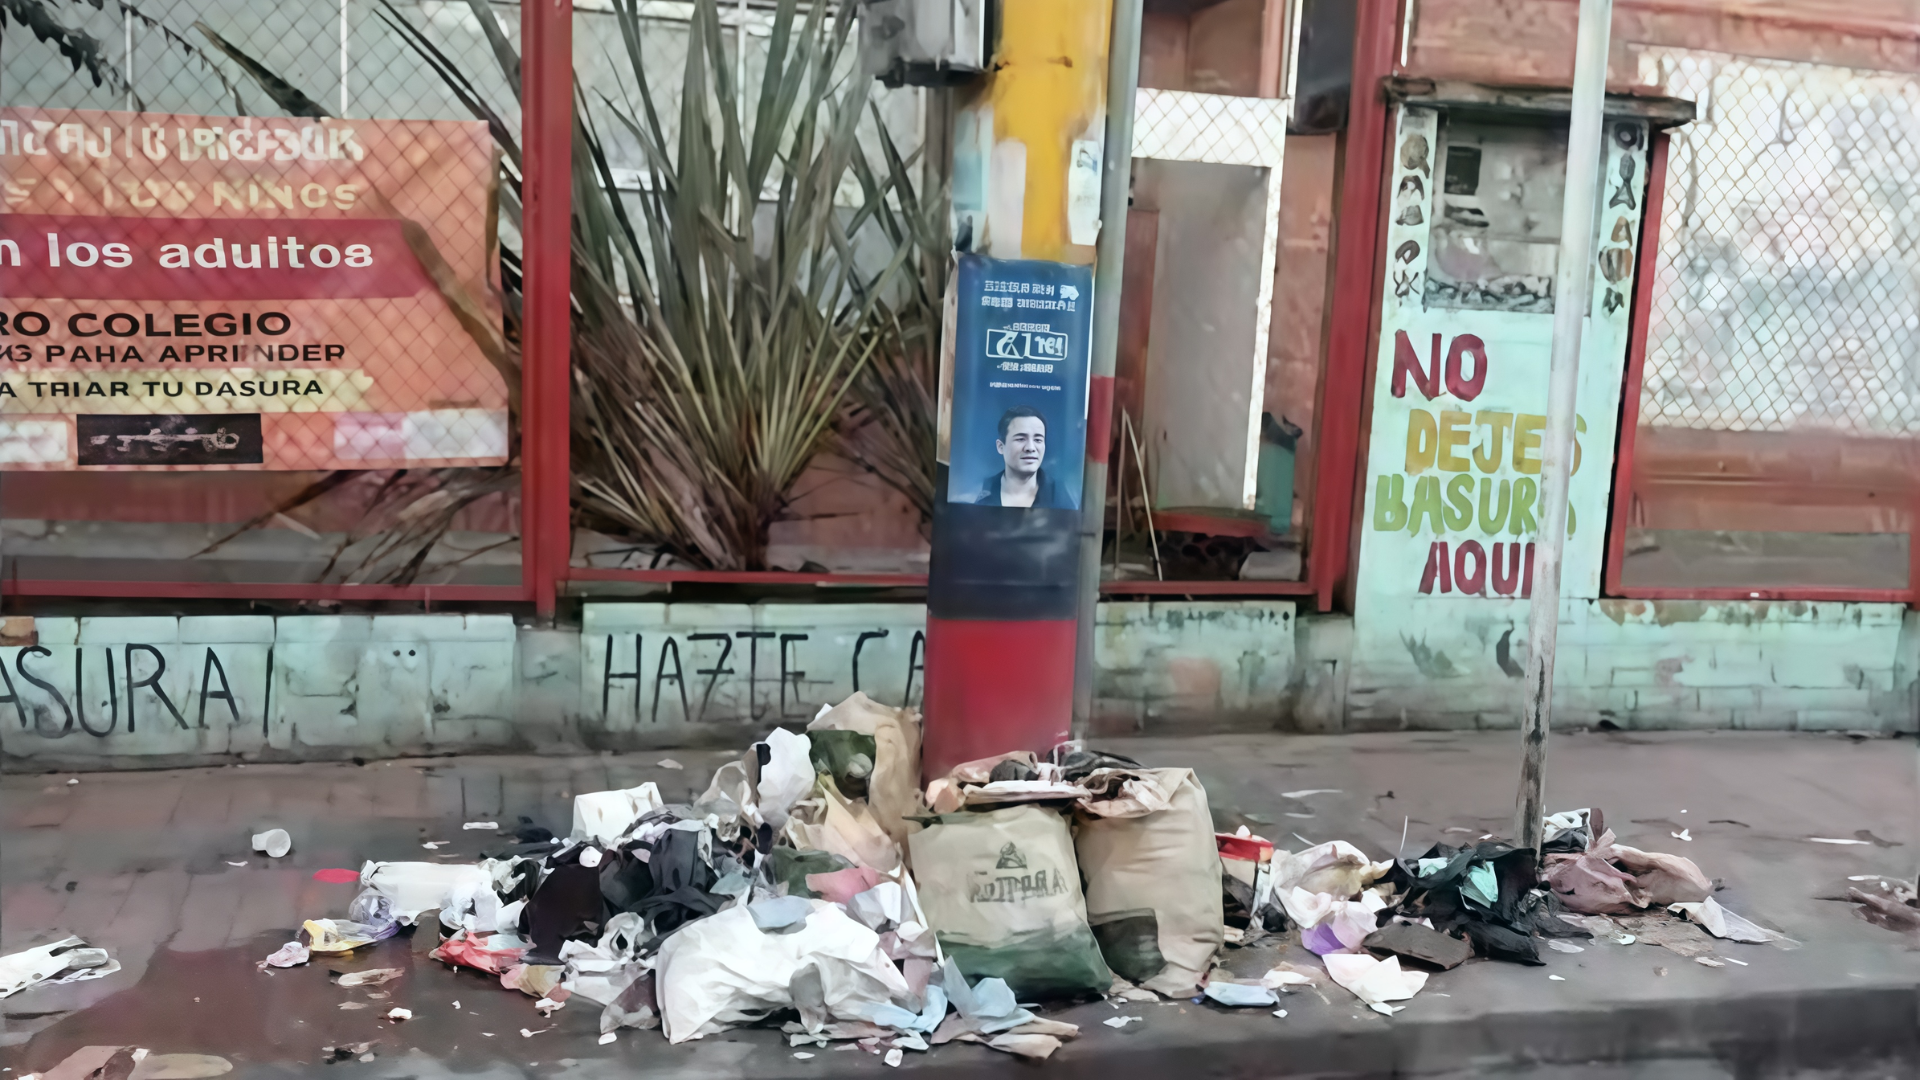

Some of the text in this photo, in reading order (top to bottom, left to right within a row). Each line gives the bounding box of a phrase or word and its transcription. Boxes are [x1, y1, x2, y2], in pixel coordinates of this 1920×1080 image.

[47, 232, 133, 268] los
[67, 312, 291, 337] COLEGIO
[1391, 328, 1488, 402] NO
[143, 381, 184, 397] TU
